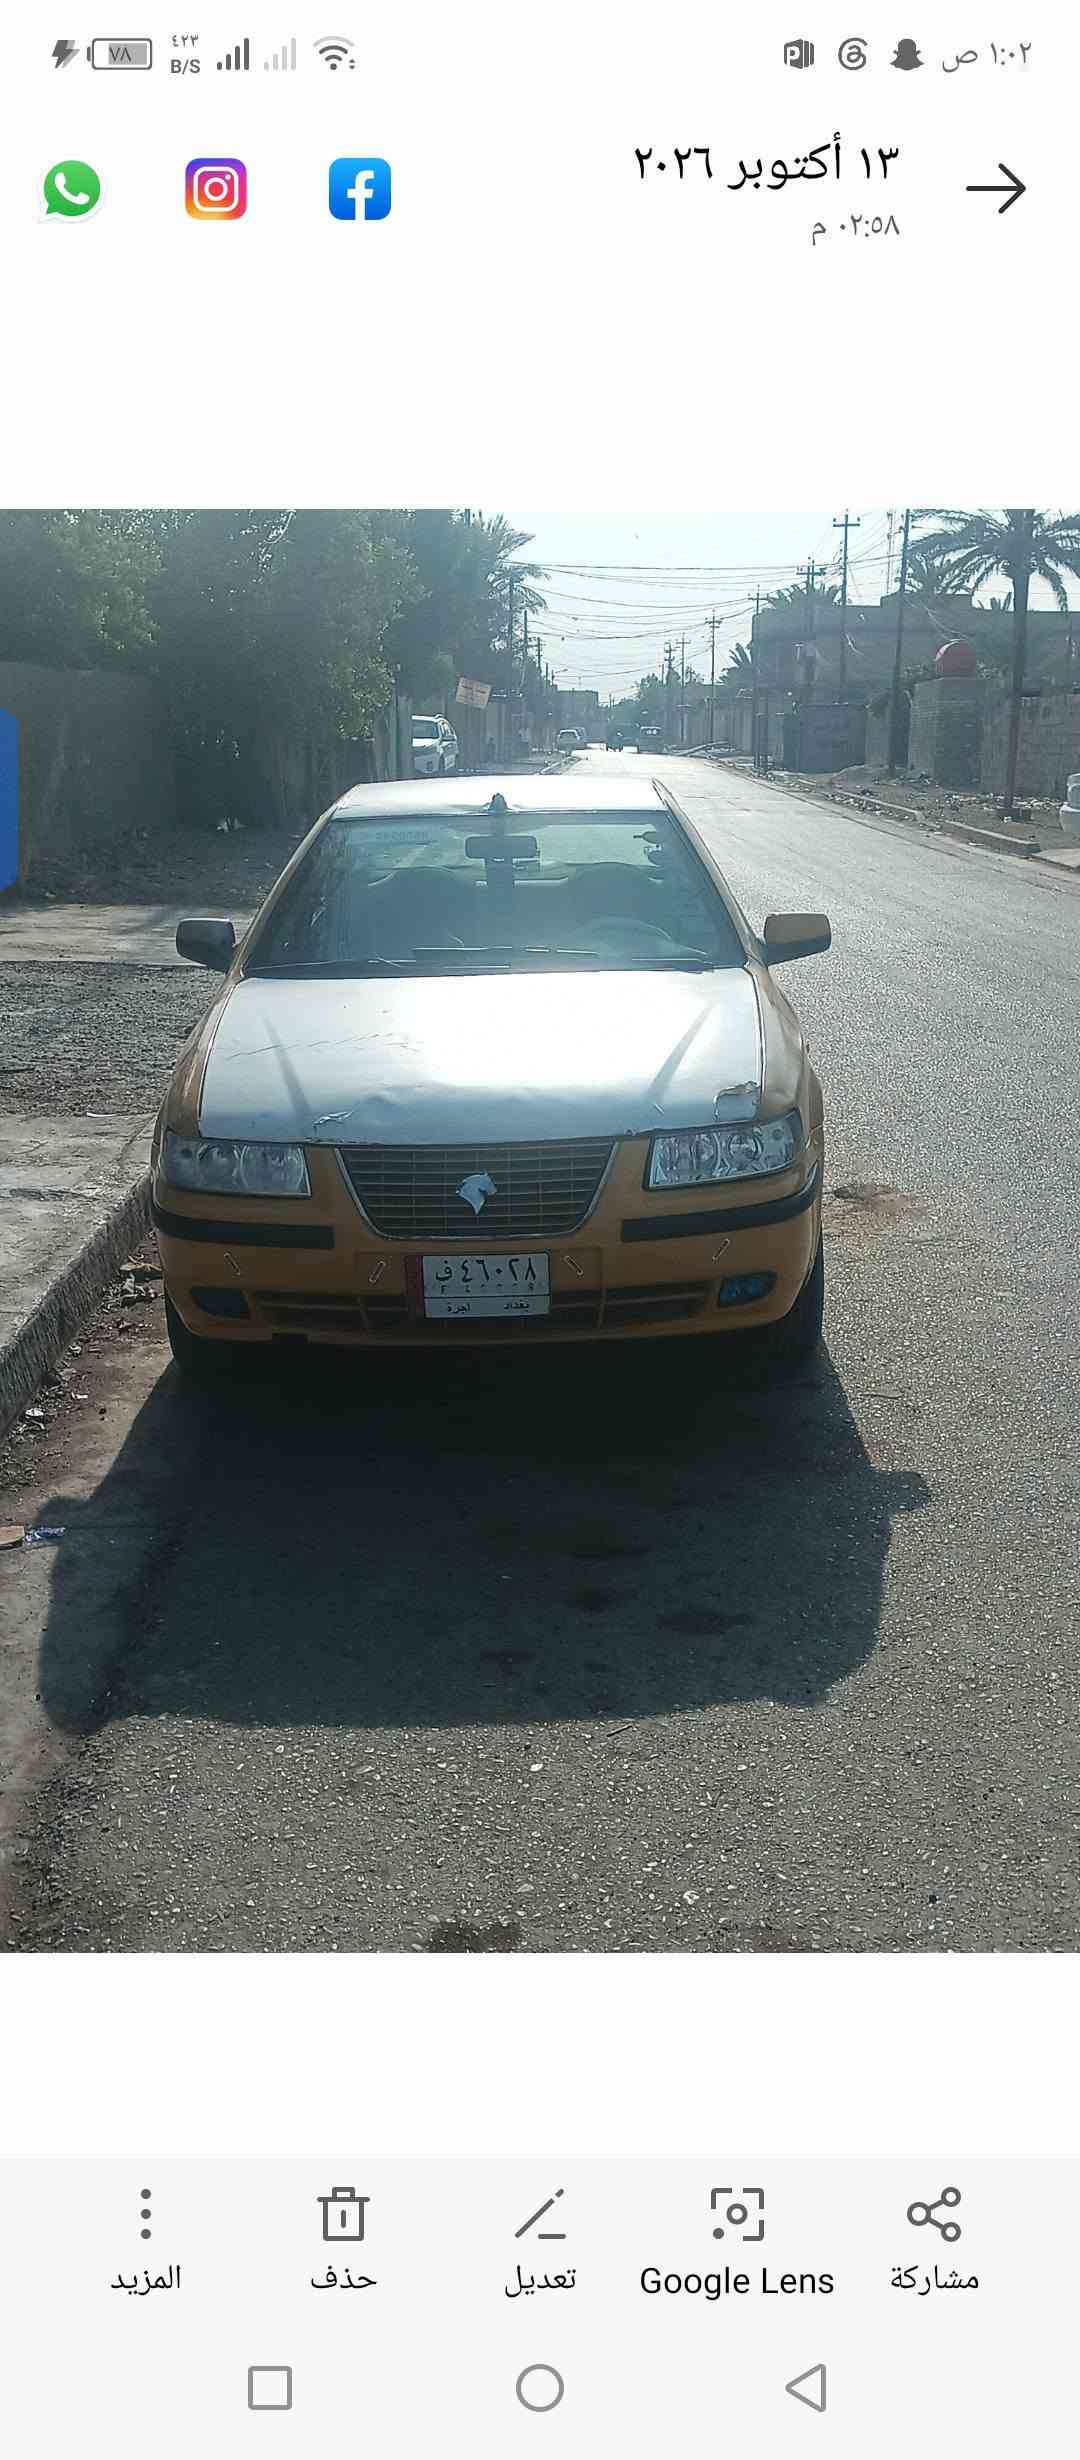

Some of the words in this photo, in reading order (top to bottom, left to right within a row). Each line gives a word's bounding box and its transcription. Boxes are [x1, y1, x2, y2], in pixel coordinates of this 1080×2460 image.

[435, 1259, 453, 1281] ف
[461, 1257, 536, 1283] ٤٦٠٢٨
[503, 1299, 530, 1312] بغداد
